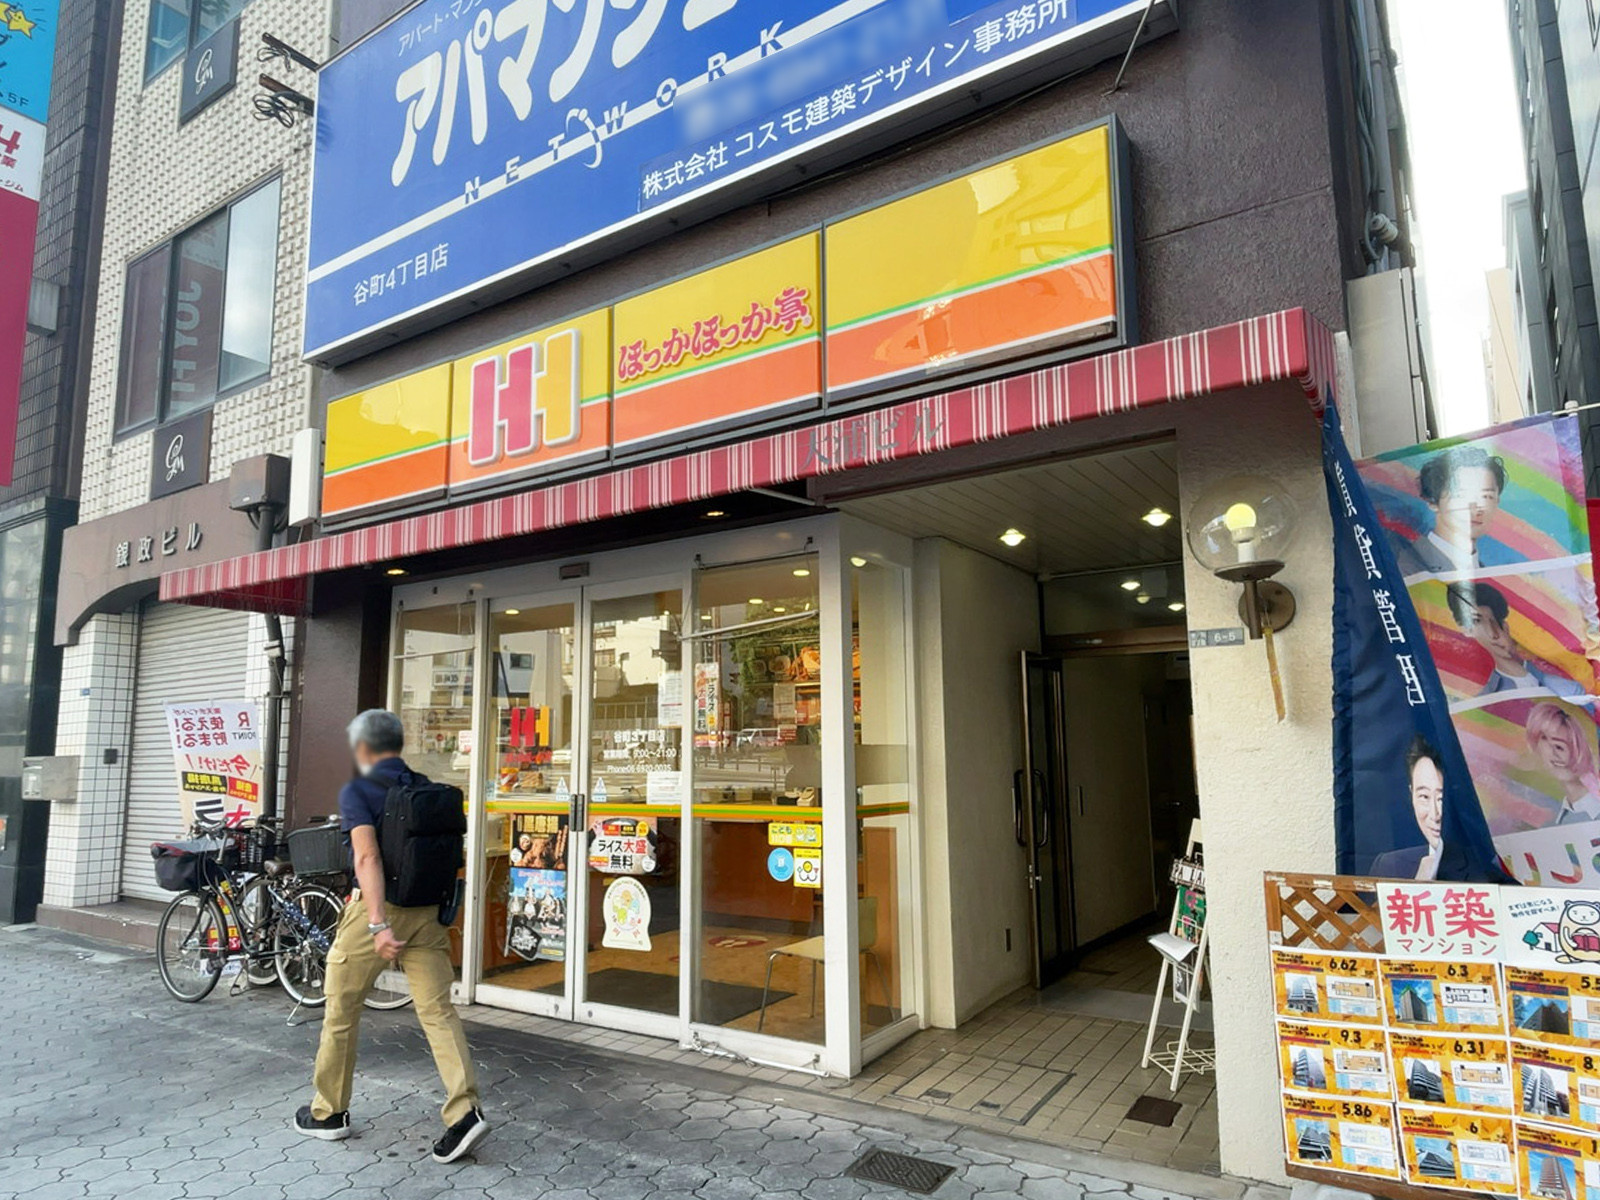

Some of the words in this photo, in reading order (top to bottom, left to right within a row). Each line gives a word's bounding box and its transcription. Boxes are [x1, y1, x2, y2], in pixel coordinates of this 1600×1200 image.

[642, 141, 728, 200] 株式会社
[353, 242, 449, 306] 谷町4丁目店
[618, 287, 811, 381] ほっかほっか亭
[115, 522, 203, 568] 銀政ビル
[598, 838, 647, 854] ライス大盛
[610, 854, 634, 870] 無料
[1386, 887, 1500, 940] 新築
[1396, 937, 1498, 957] マンション
[1329, 957, 1358, 972] 6.62
[1447, 963, 1469, 977] 6.3
[1340, 1029, 1362, 1043] 9.3
[1453, 1040, 1485, 1054] 6.31
[1342, 1102, 1373, 1118] 5.86
[1469, 1121, 1479, 1134] 6
